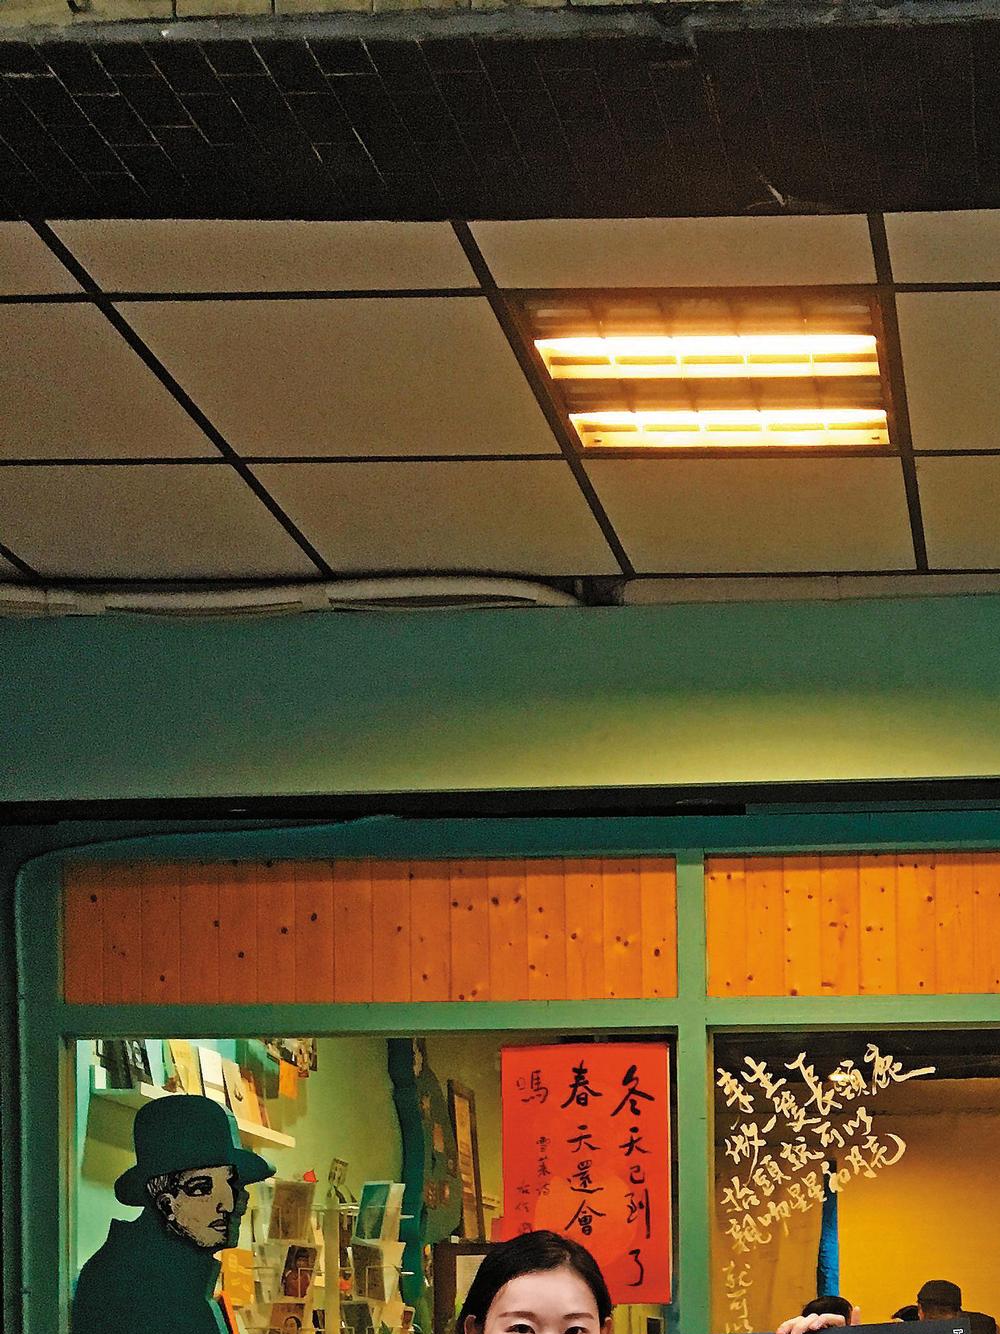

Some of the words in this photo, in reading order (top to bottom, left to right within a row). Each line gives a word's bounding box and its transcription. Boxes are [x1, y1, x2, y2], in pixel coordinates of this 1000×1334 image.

[561, 1060, 606, 1236] 春天還會
[611, 1065, 655, 1287] 冬天已到了
